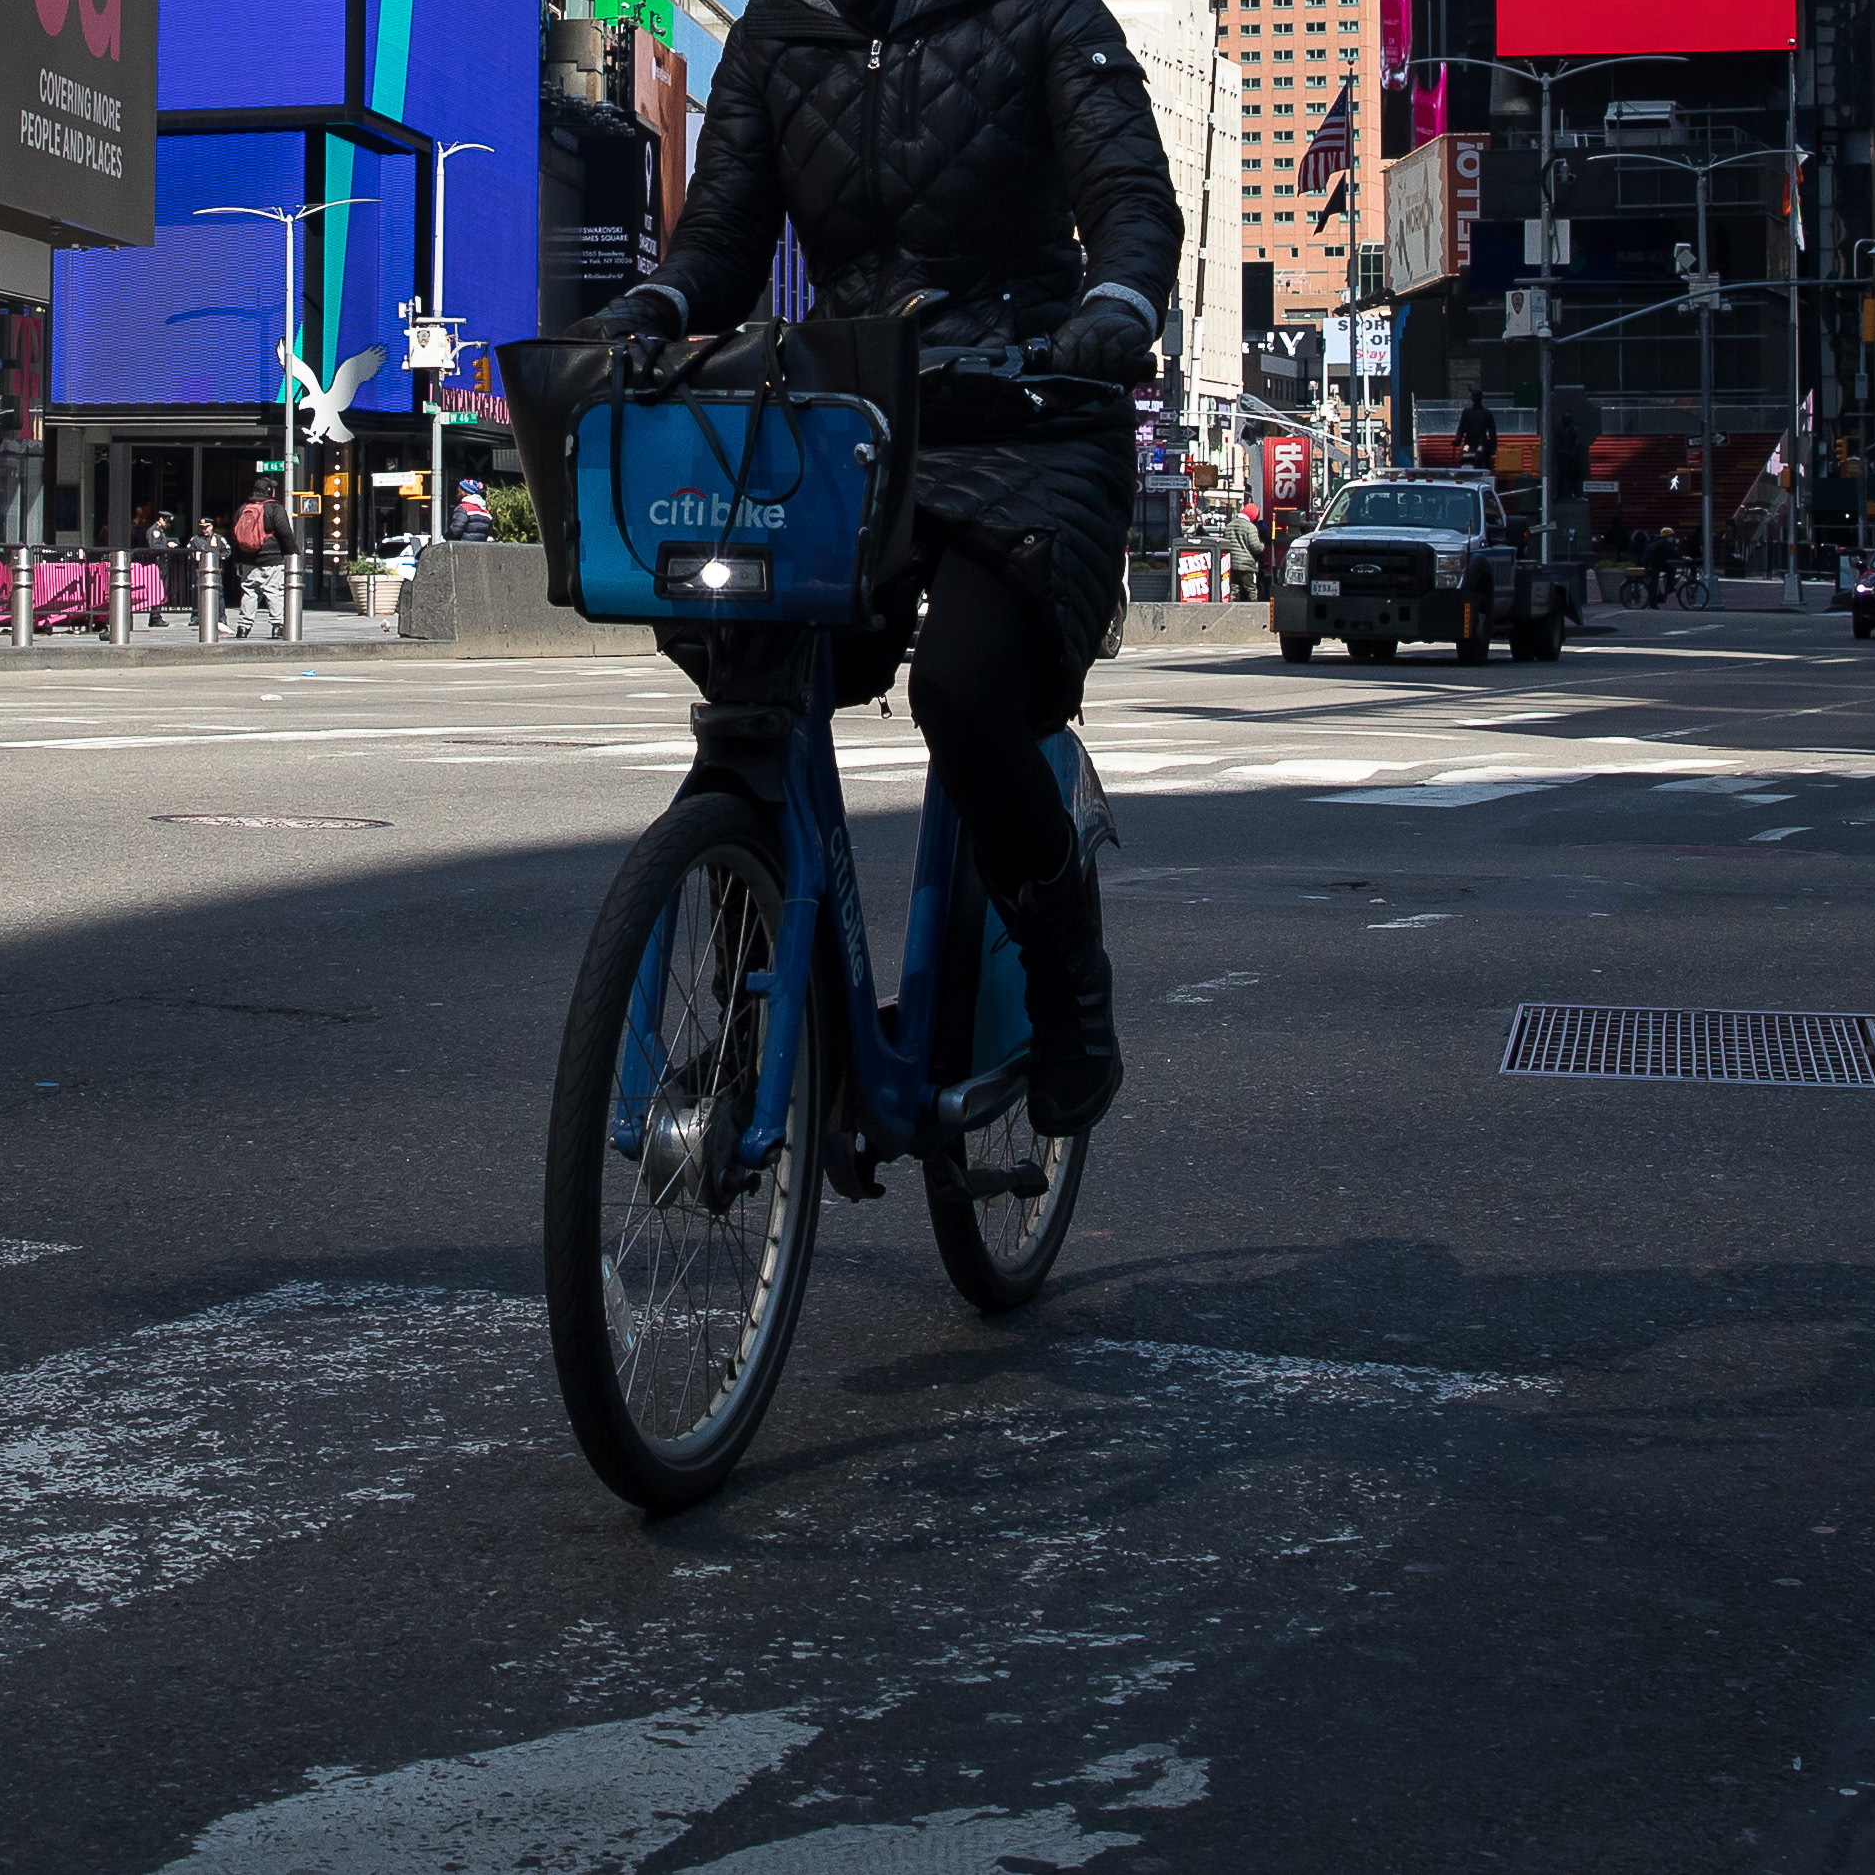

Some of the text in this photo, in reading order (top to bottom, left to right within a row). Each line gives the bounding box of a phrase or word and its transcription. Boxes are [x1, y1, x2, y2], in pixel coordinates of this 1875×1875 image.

[38, 67, 122, 133] COVERING MORE
[20, 109, 124, 179] PEOPLE AND PLACES
[1275, 442, 1303, 500] tkts
[649, 497, 706, 527] citi
[1178, 551, 1212, 575] JERSEY
